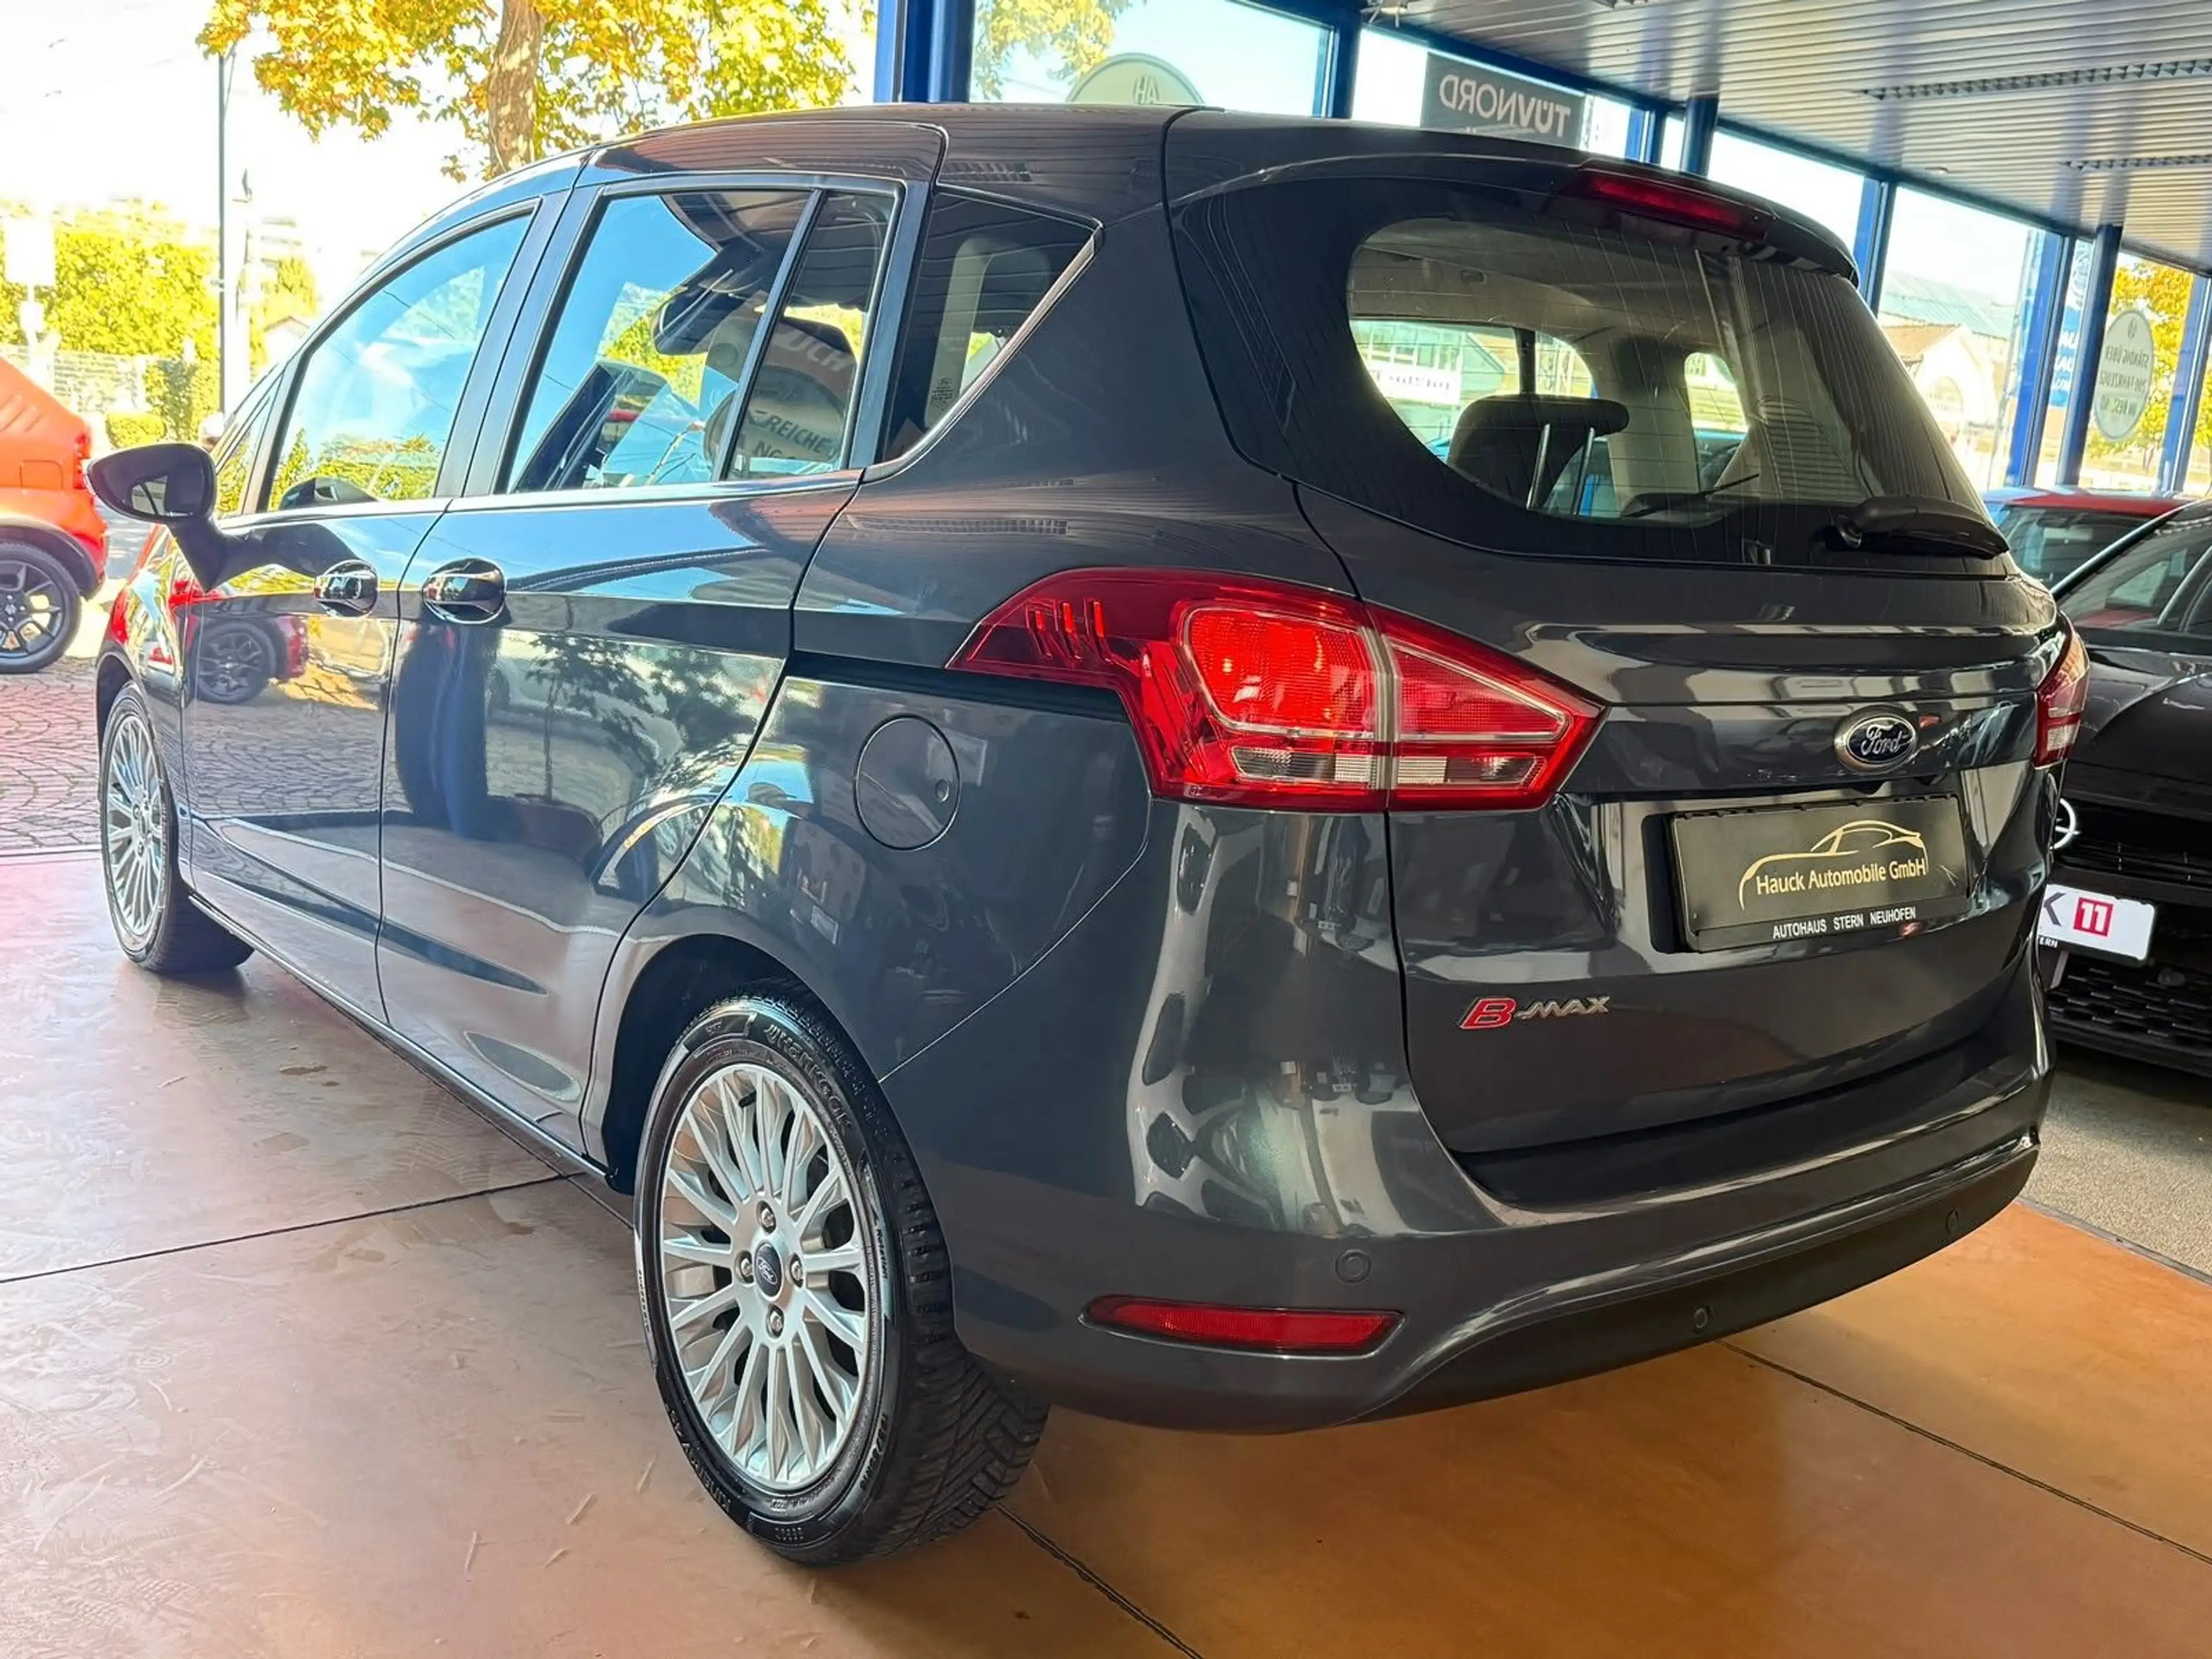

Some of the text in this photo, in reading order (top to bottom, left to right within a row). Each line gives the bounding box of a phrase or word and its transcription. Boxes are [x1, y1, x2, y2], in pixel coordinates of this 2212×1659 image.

[1859, 723, 1907, 756] Ford
[1757, 858, 1926, 895] Hauck Automobile GmbH
[1772, 906, 1916, 940] AUTOHAUS STERN NEUHOFEN
[1459, 996, 1611, 1030] B-MAX
